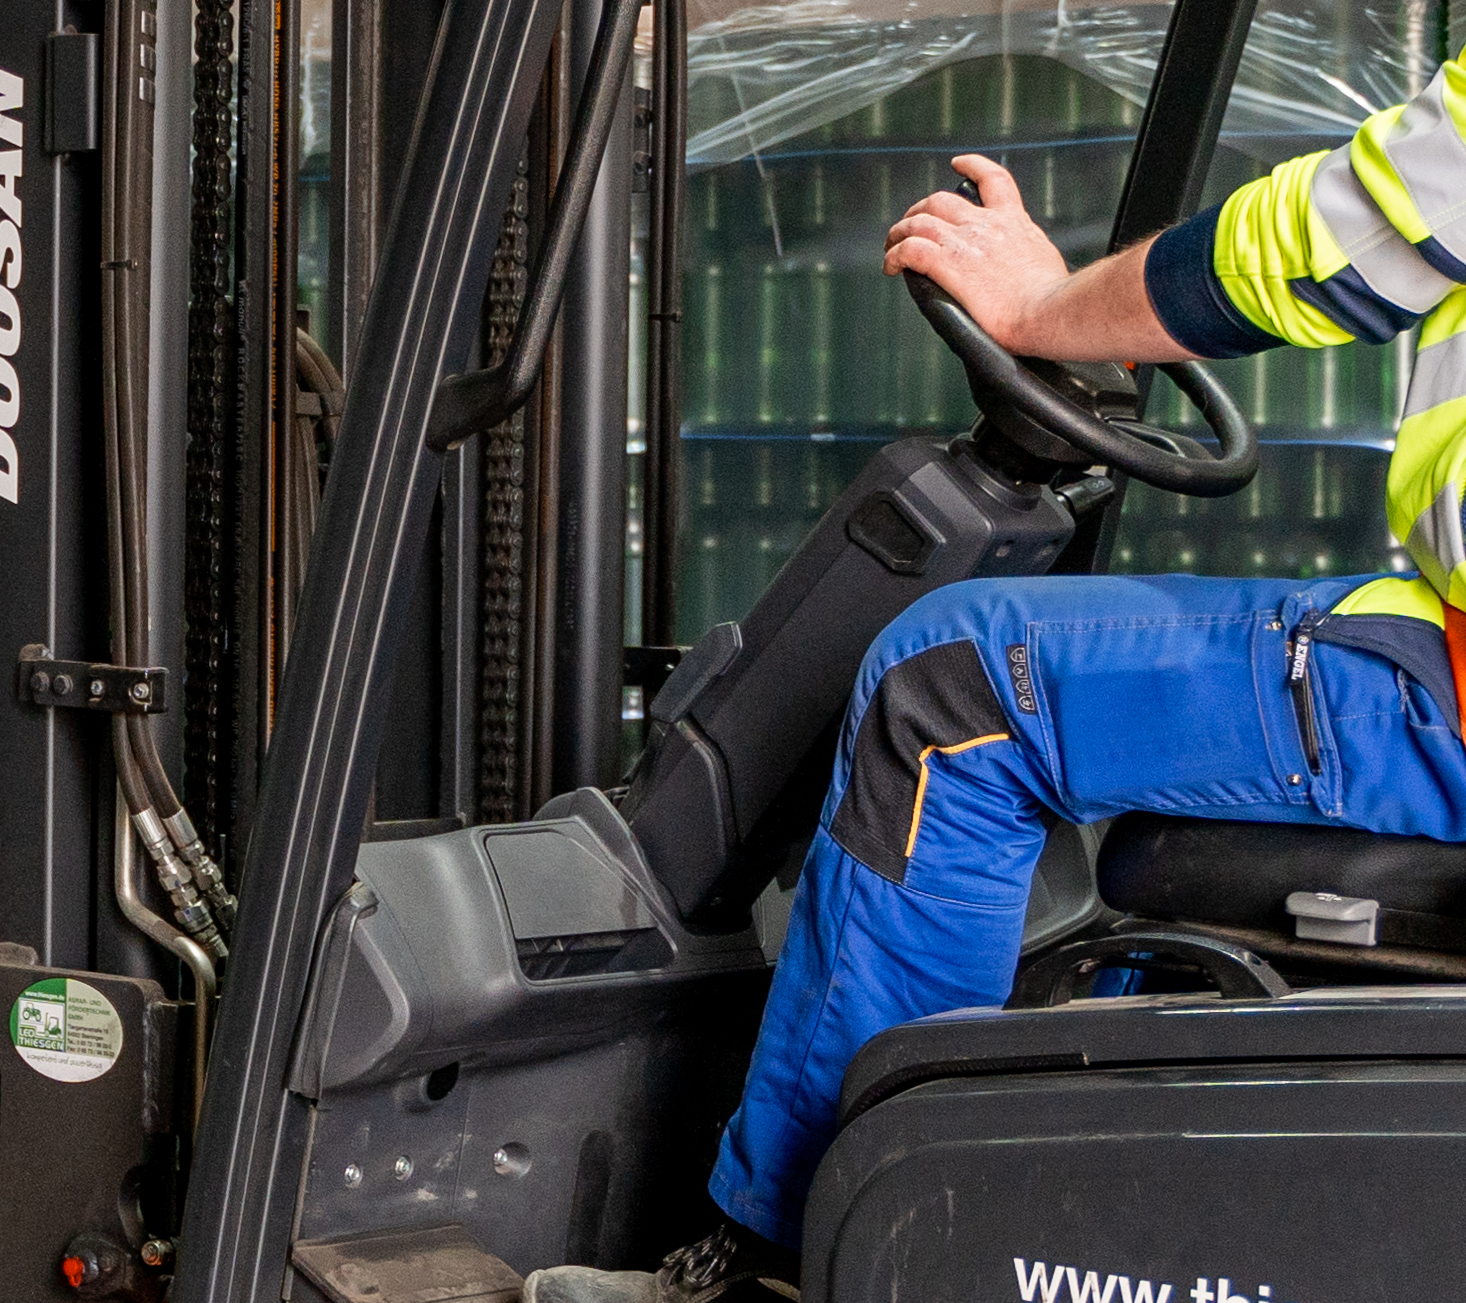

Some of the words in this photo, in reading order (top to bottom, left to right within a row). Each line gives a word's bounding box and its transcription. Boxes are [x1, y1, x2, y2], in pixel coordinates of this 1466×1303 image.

[1291, 643, 1308, 680] ENGEL
[19, 1028, 35, 1037] LEO
[19, 1037, 64, 1052] THIESGEN
